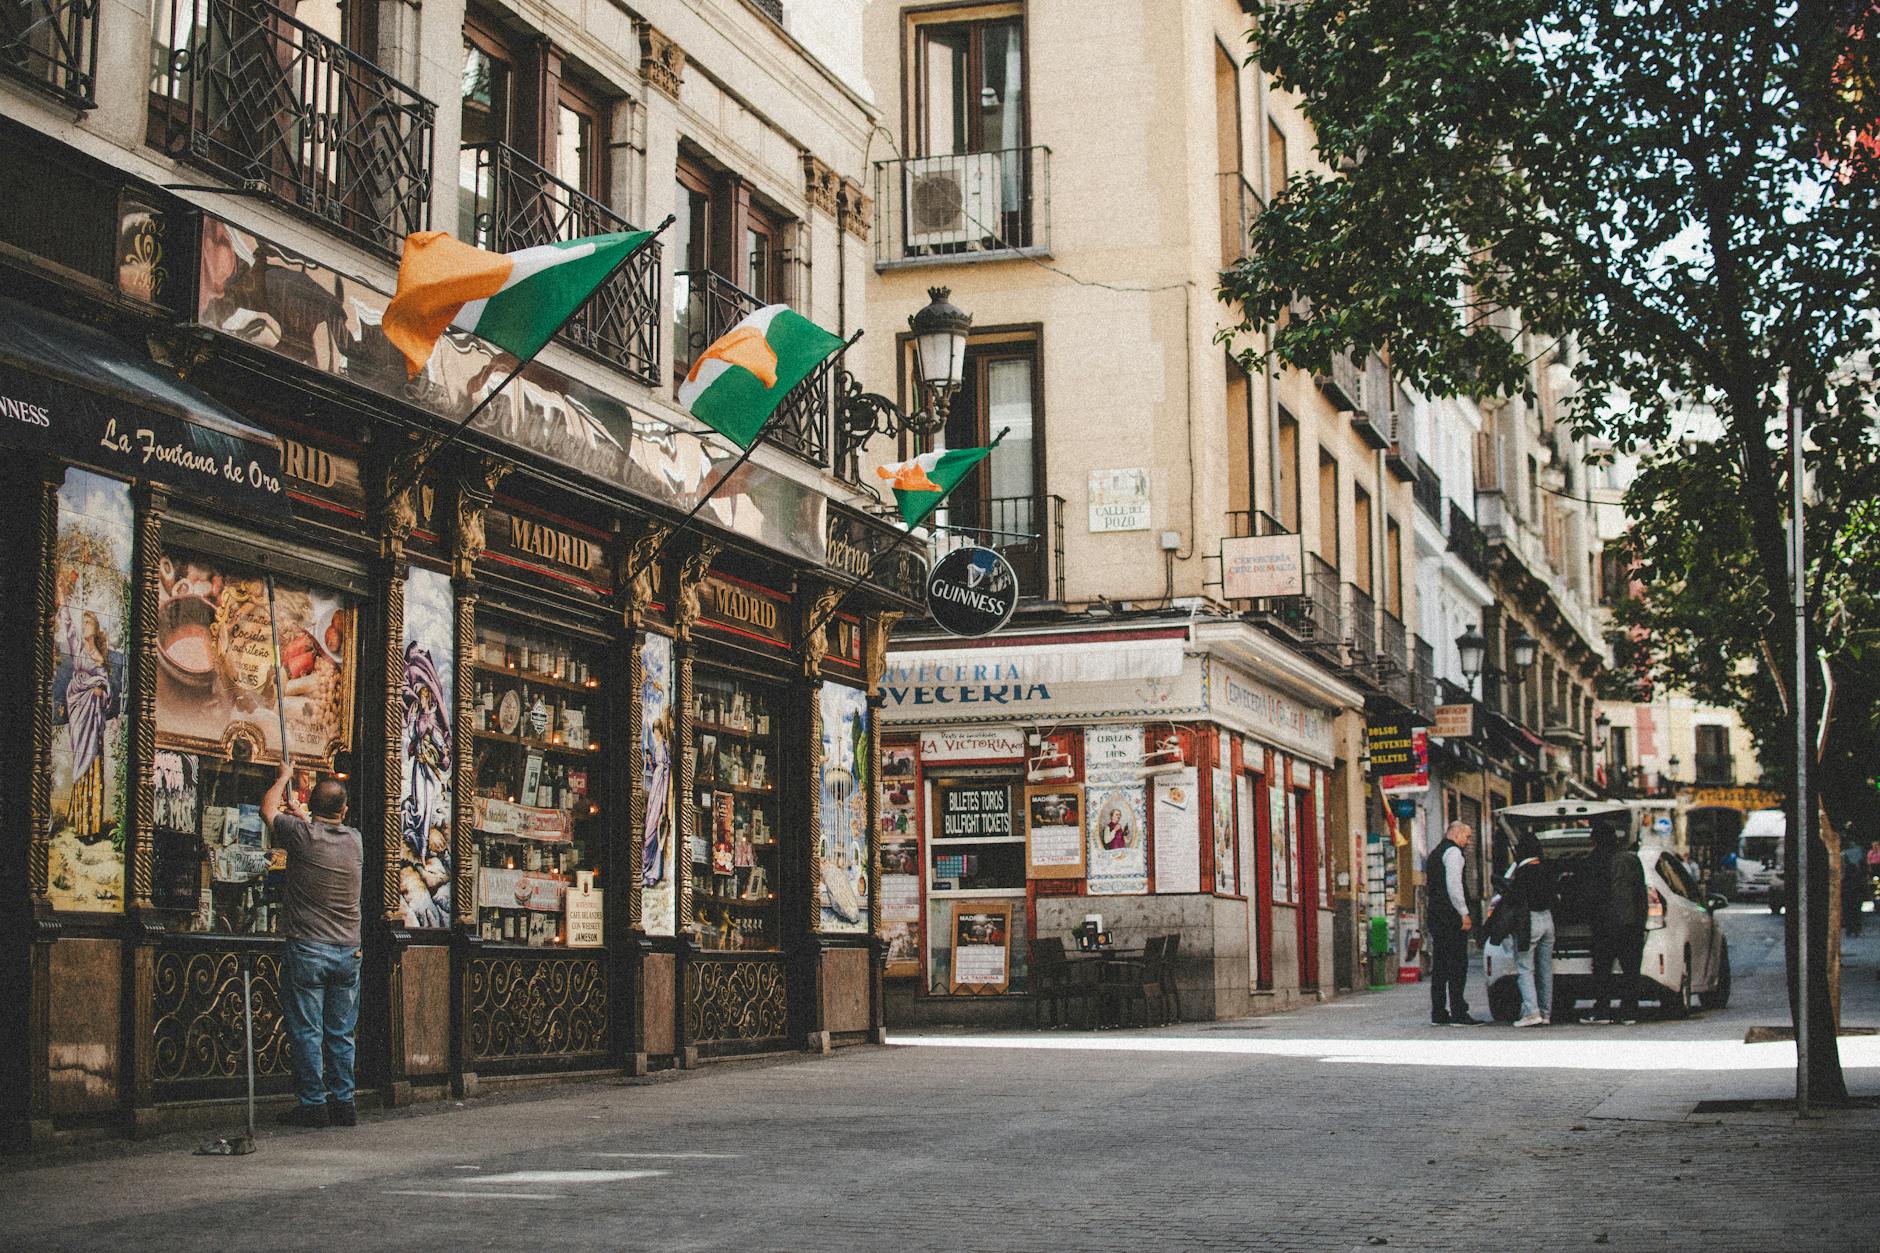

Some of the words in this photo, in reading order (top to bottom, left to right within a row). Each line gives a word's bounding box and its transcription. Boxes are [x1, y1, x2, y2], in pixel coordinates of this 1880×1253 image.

[101, 417, 132, 453] La
[136, 429, 218, 476] Fontana
[224, 456, 244, 484] de
[249, 461, 281, 494] Oro
[279, 438, 337, 488] RID
[1105, 516, 1136, 528] POZO
[510, 515, 592, 571] MADRID
[713, 583, 776, 630] MADRID
[932, 579, 1005, 616] GUINNESS
[1368, 726, 1398, 736] BOLSOS
[921, 740, 938, 754] LA
[945, 739, 1014, 754] VICTORIA
[1371, 753, 1407, 764] MALETAS
[949, 791, 980, 811] BILLETES
[981, 790, 1004, 811] TOROS
[945, 814, 980, 834] BULLFIGHT
[981, 812, 1009, 833] TICKETS
